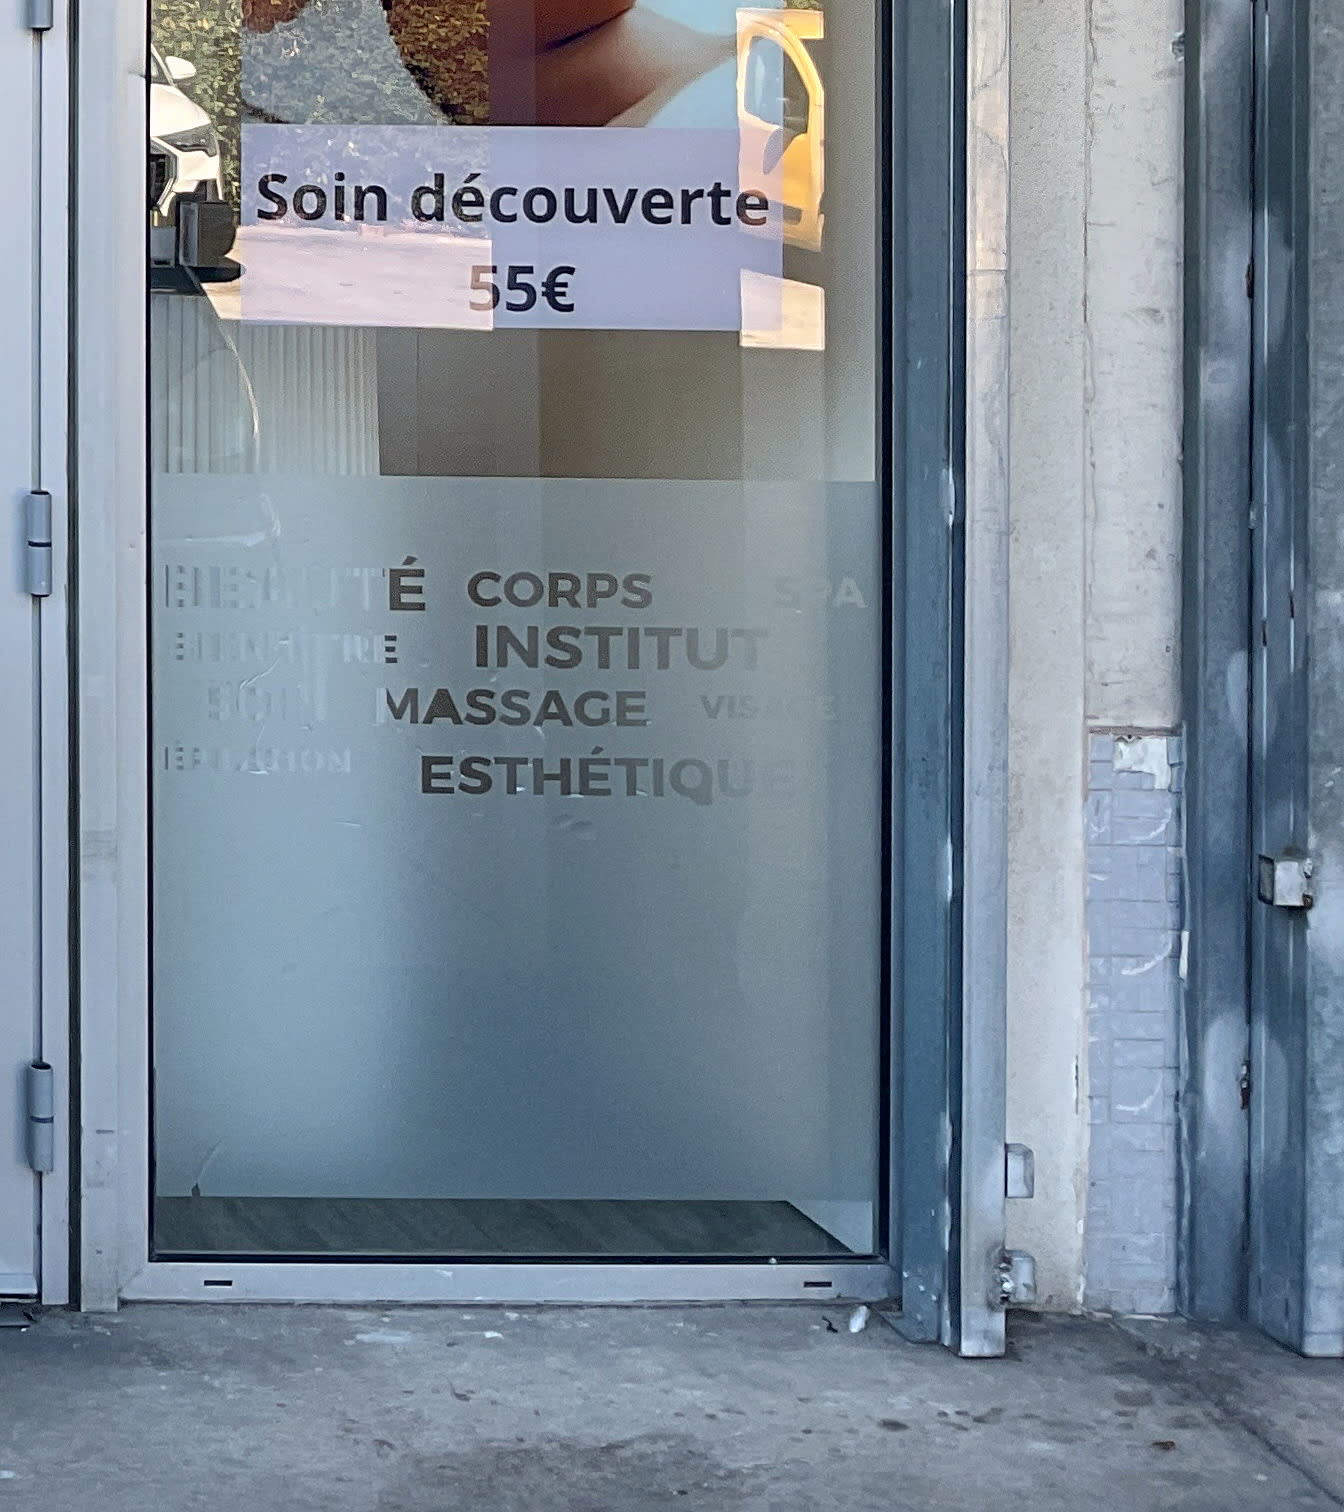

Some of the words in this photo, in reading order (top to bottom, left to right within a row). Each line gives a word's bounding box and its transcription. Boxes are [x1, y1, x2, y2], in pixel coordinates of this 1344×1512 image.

[257, 173, 387, 223] Soin
[411, 172, 768, 225] découverte
[468, 265, 575, 313] 55€
[467, 571, 653, 610] CORPS
[774, 574, 868, 609] SA
[475, 625, 769, 671] INSTITUT
[378, 688, 650, 728] MASSAGE
[698, 695, 836, 720] VISE
[421, 746, 794, 806] ESTHÉTIQU
